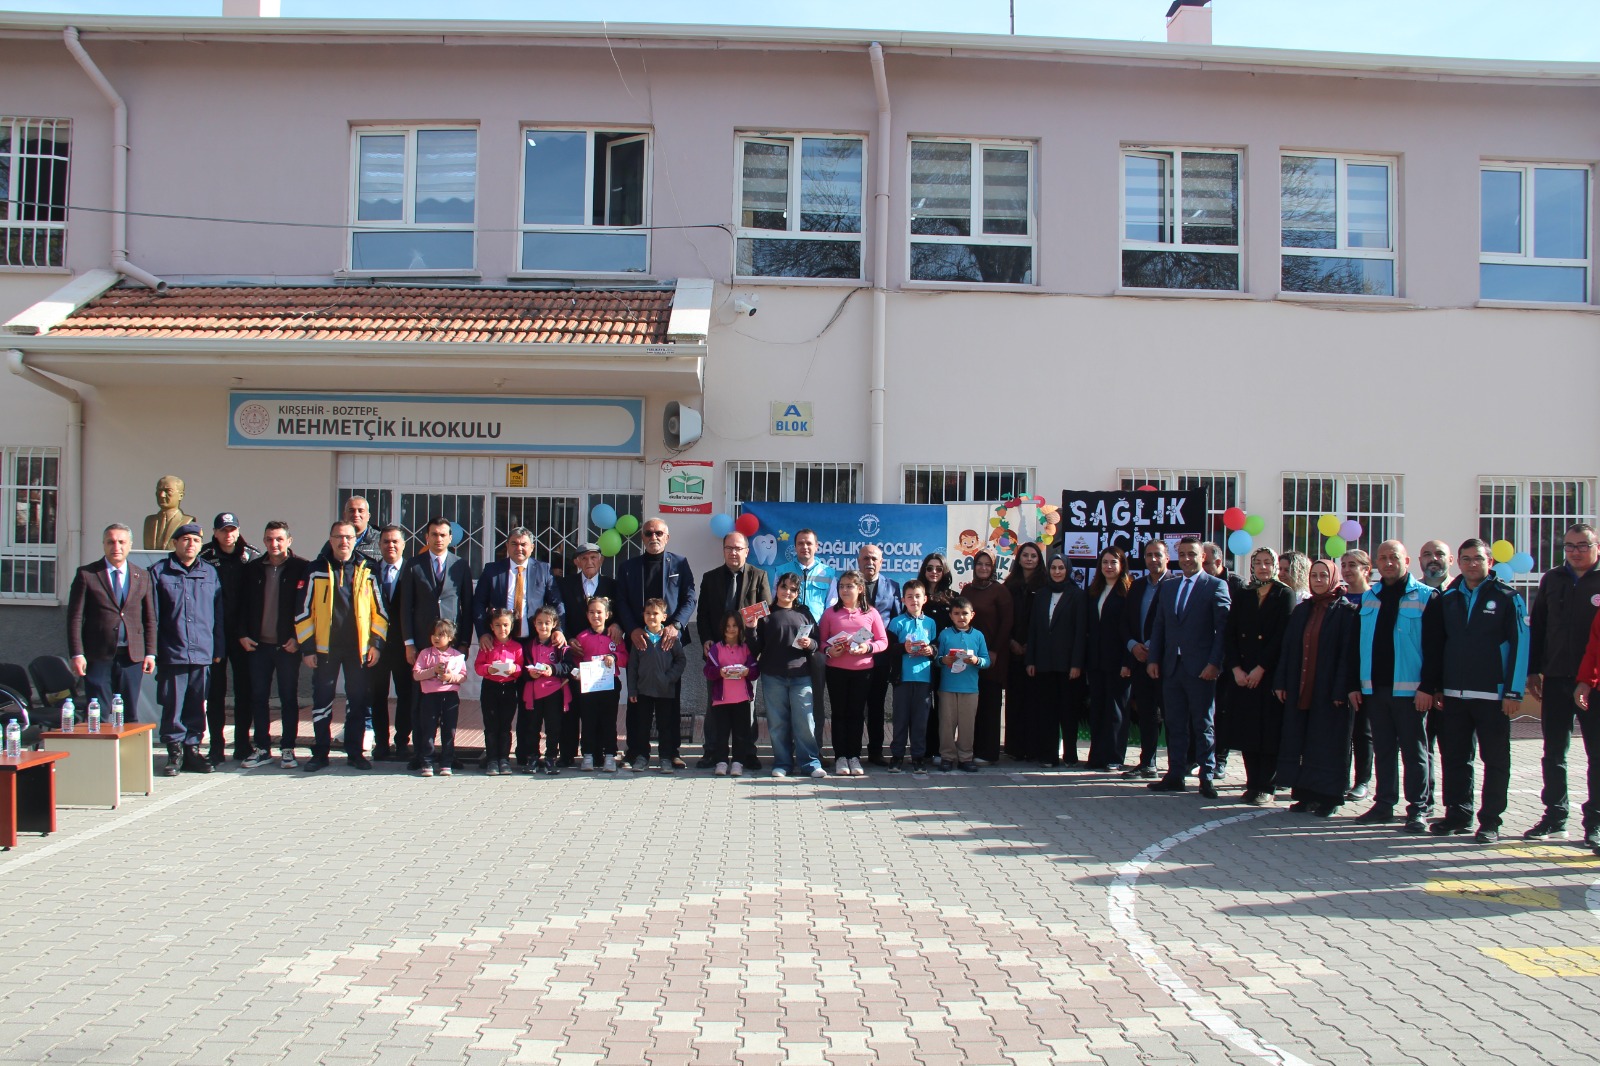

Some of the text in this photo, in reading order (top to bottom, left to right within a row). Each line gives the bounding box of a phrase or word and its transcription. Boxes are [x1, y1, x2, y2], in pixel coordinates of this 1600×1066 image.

[278, 403, 324, 417] KIRŞEHİR
[332, 406, 379, 416] BOZTEPE
[783, 404, 802, 417] A
[277, 416, 502, 441] MEHMETÇİK İLKOKULU
[775, 420, 808, 432] BLOK
[1069, 497, 1187, 528] SAĞLIK
[815, 539, 872, 555] SAĞLIK
[879, 558, 922, 573] ELECE
[953, 555, 1011, 575] SAIK
